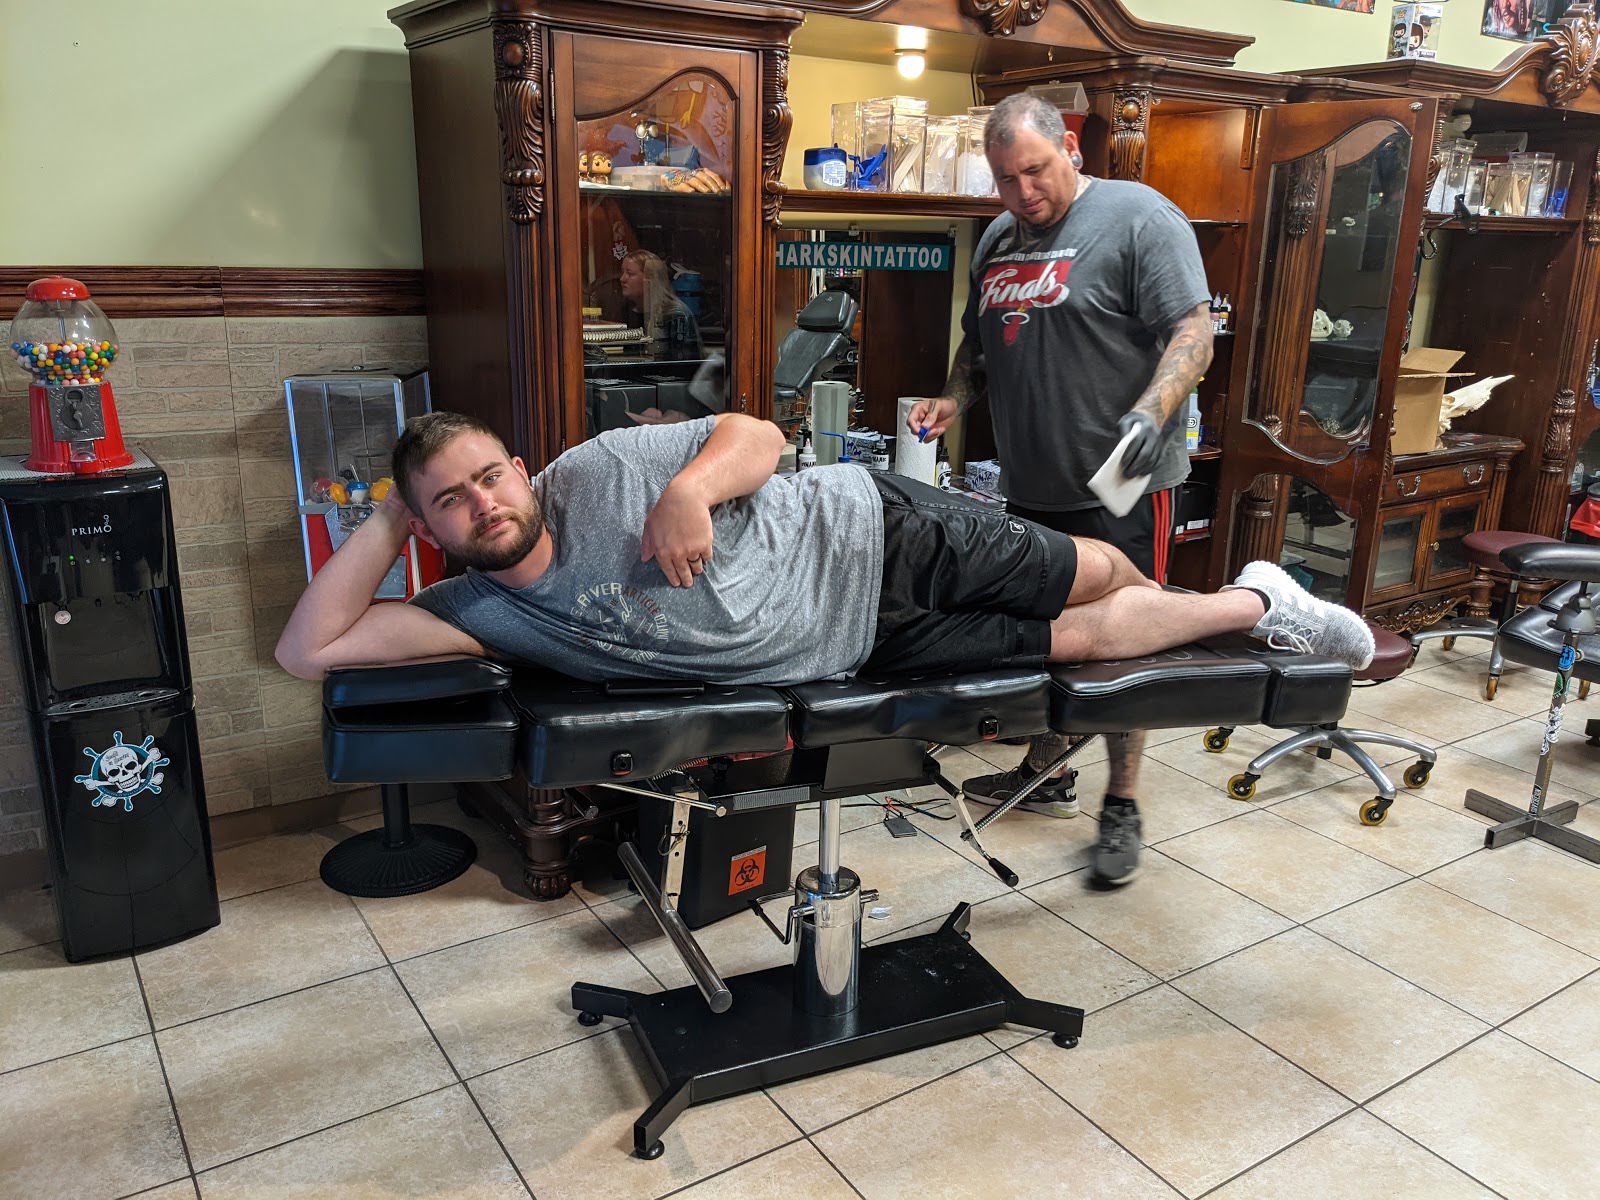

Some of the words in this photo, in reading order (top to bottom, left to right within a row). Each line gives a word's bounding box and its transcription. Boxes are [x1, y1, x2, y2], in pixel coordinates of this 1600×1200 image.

[775, 243, 942, 269] HARKSKINTATTOO
[71, 525, 112, 536] PRIMO
[577, 582, 622, 607] RIVER
